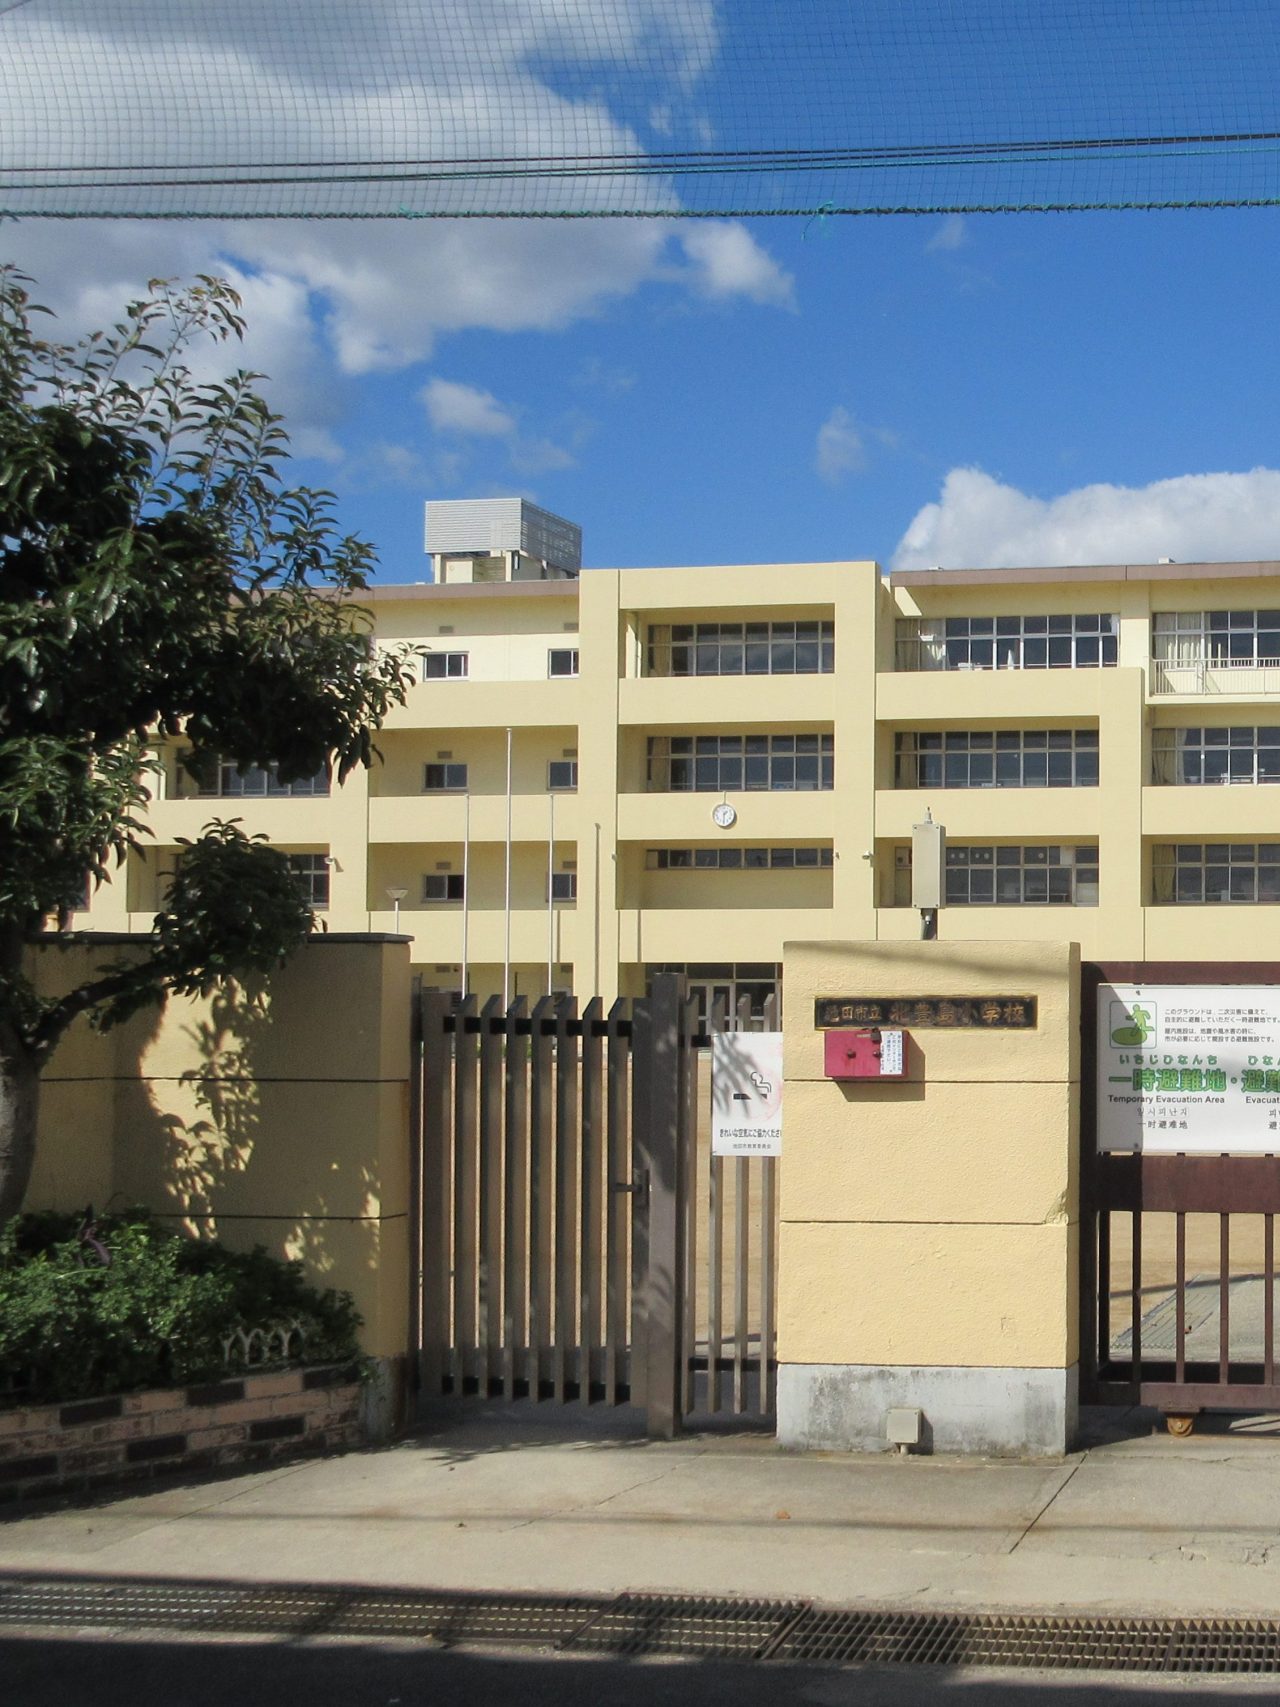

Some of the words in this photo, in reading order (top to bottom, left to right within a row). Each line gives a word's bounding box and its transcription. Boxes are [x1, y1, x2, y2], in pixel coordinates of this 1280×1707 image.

[1119, 1054, 1218, 1066] いちじひなんち
[1108, 1095, 1154, 1105] Temporary
[1156, 1095, 1203, 1104] Evacuation
[1205, 1096, 1225, 1104] Area
